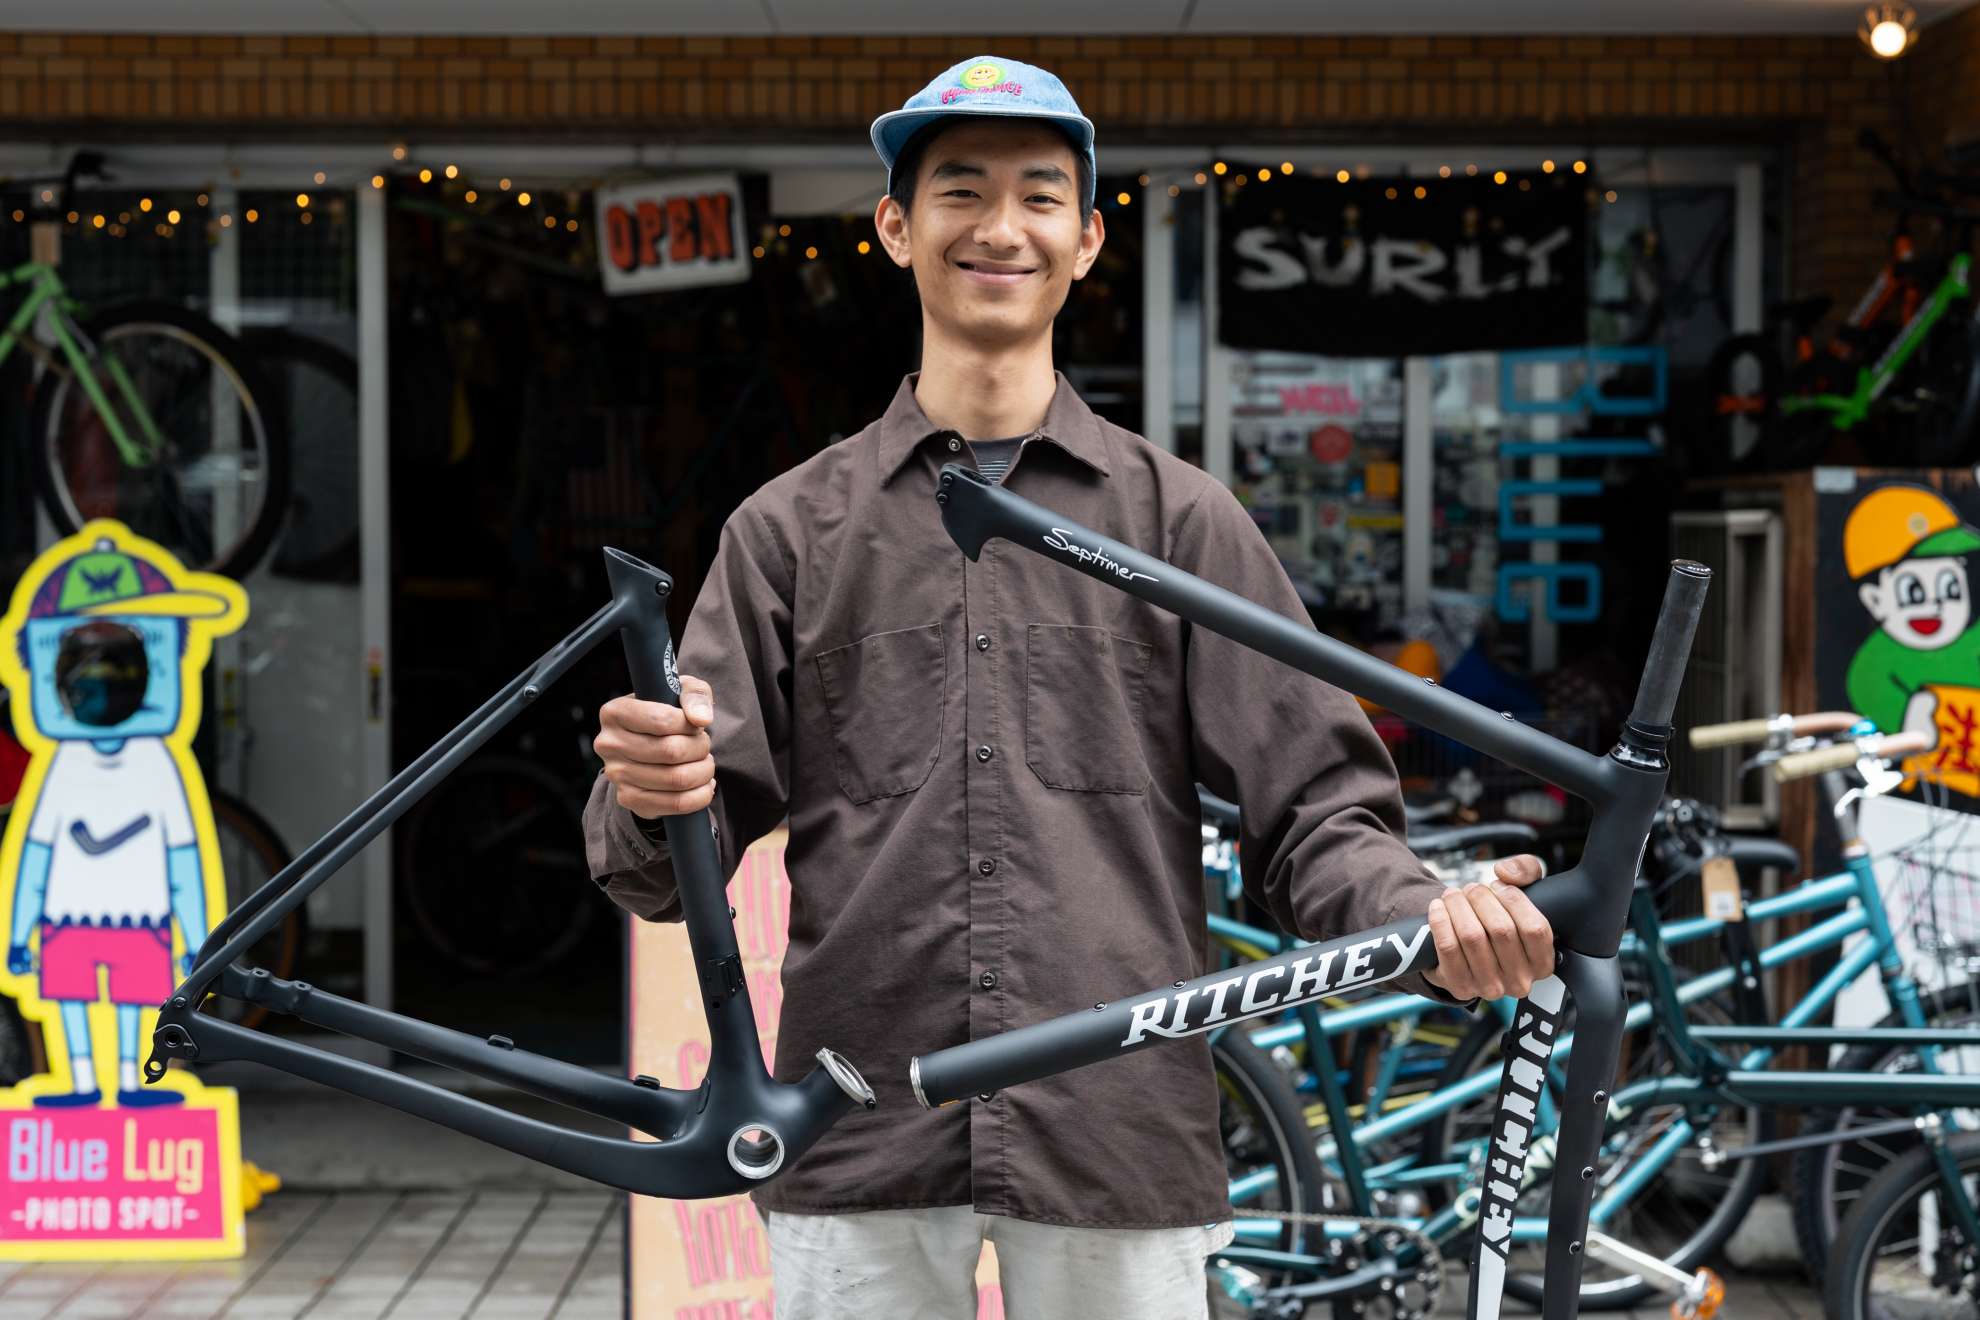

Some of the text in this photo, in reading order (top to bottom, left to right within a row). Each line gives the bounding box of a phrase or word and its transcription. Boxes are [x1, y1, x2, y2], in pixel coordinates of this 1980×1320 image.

[606, 191, 735, 273] OPEN
[1234, 227, 1570, 299] SURLY
[1042, 527, 1160, 583] Septimer
[1120, 924, 1431, 1048] RITCHEY
[9, 1117, 203, 1195] Blue Lug
[1478, 1003, 1561, 1266] RITCHEY
